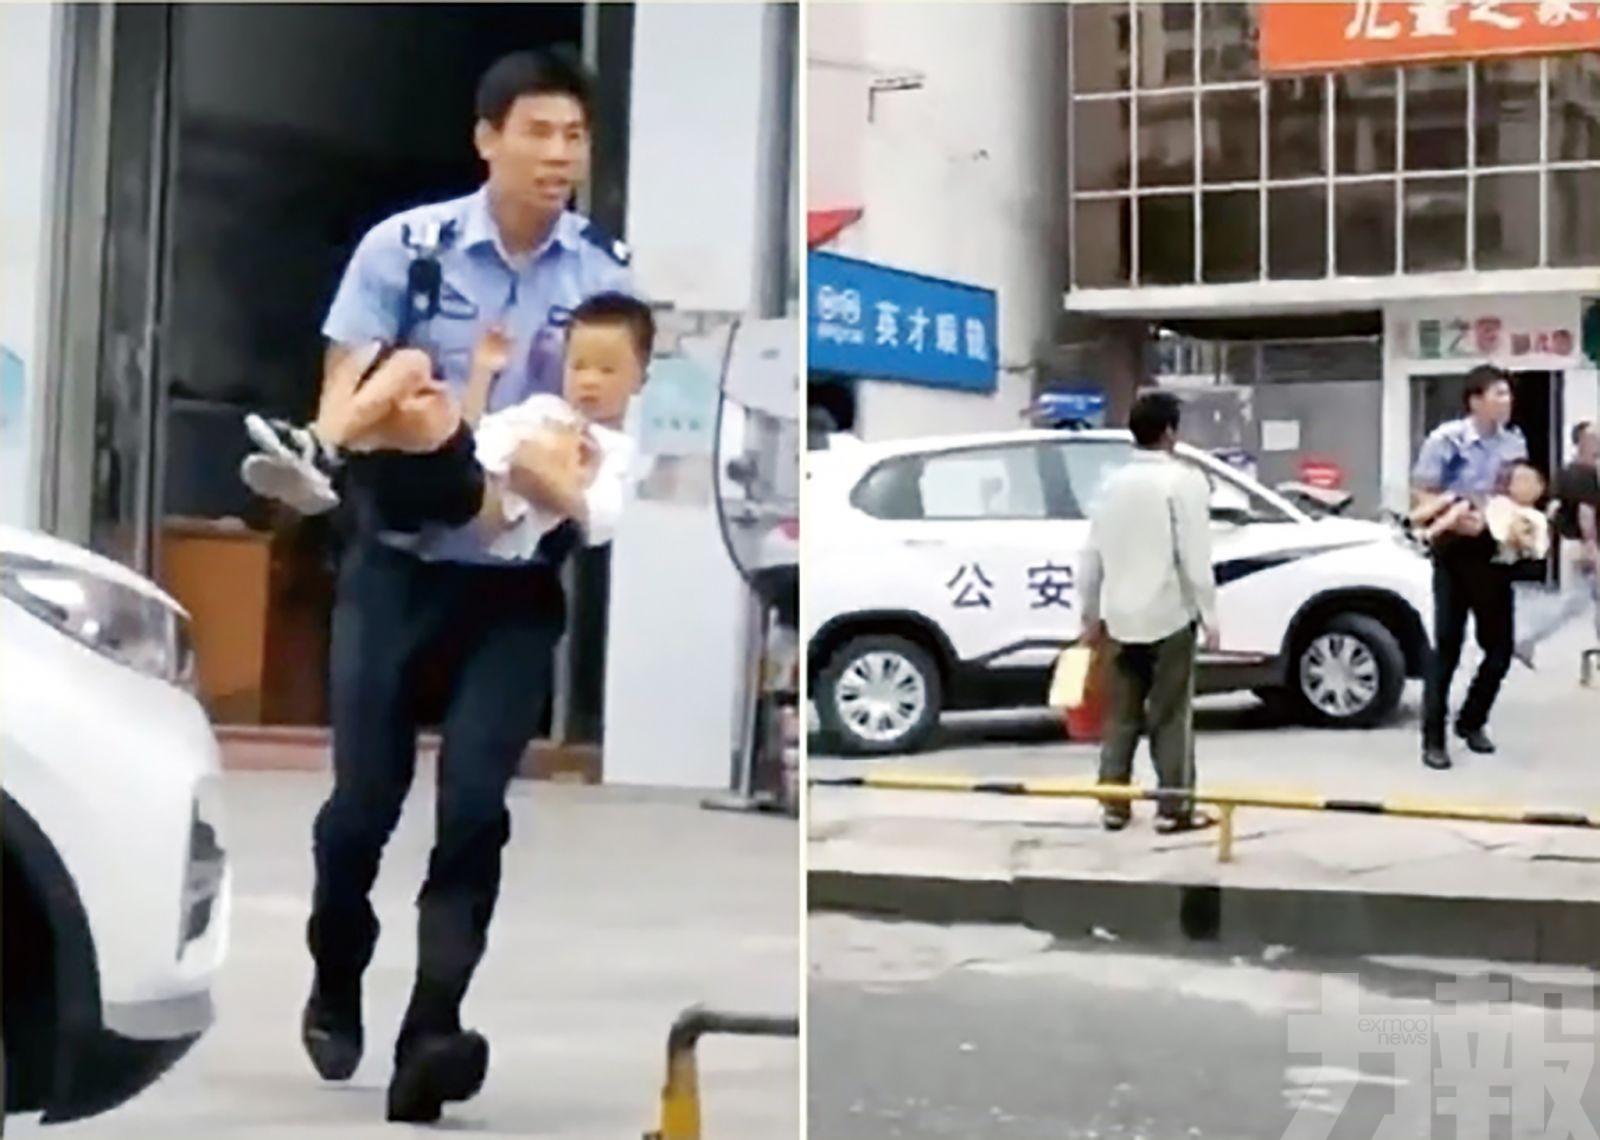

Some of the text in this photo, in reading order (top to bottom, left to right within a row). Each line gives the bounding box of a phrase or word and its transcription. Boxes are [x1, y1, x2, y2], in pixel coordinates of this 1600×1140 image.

[1344, 2, 1600, 40] 儿童之家
[945, 561, 1074, 609] 公安
